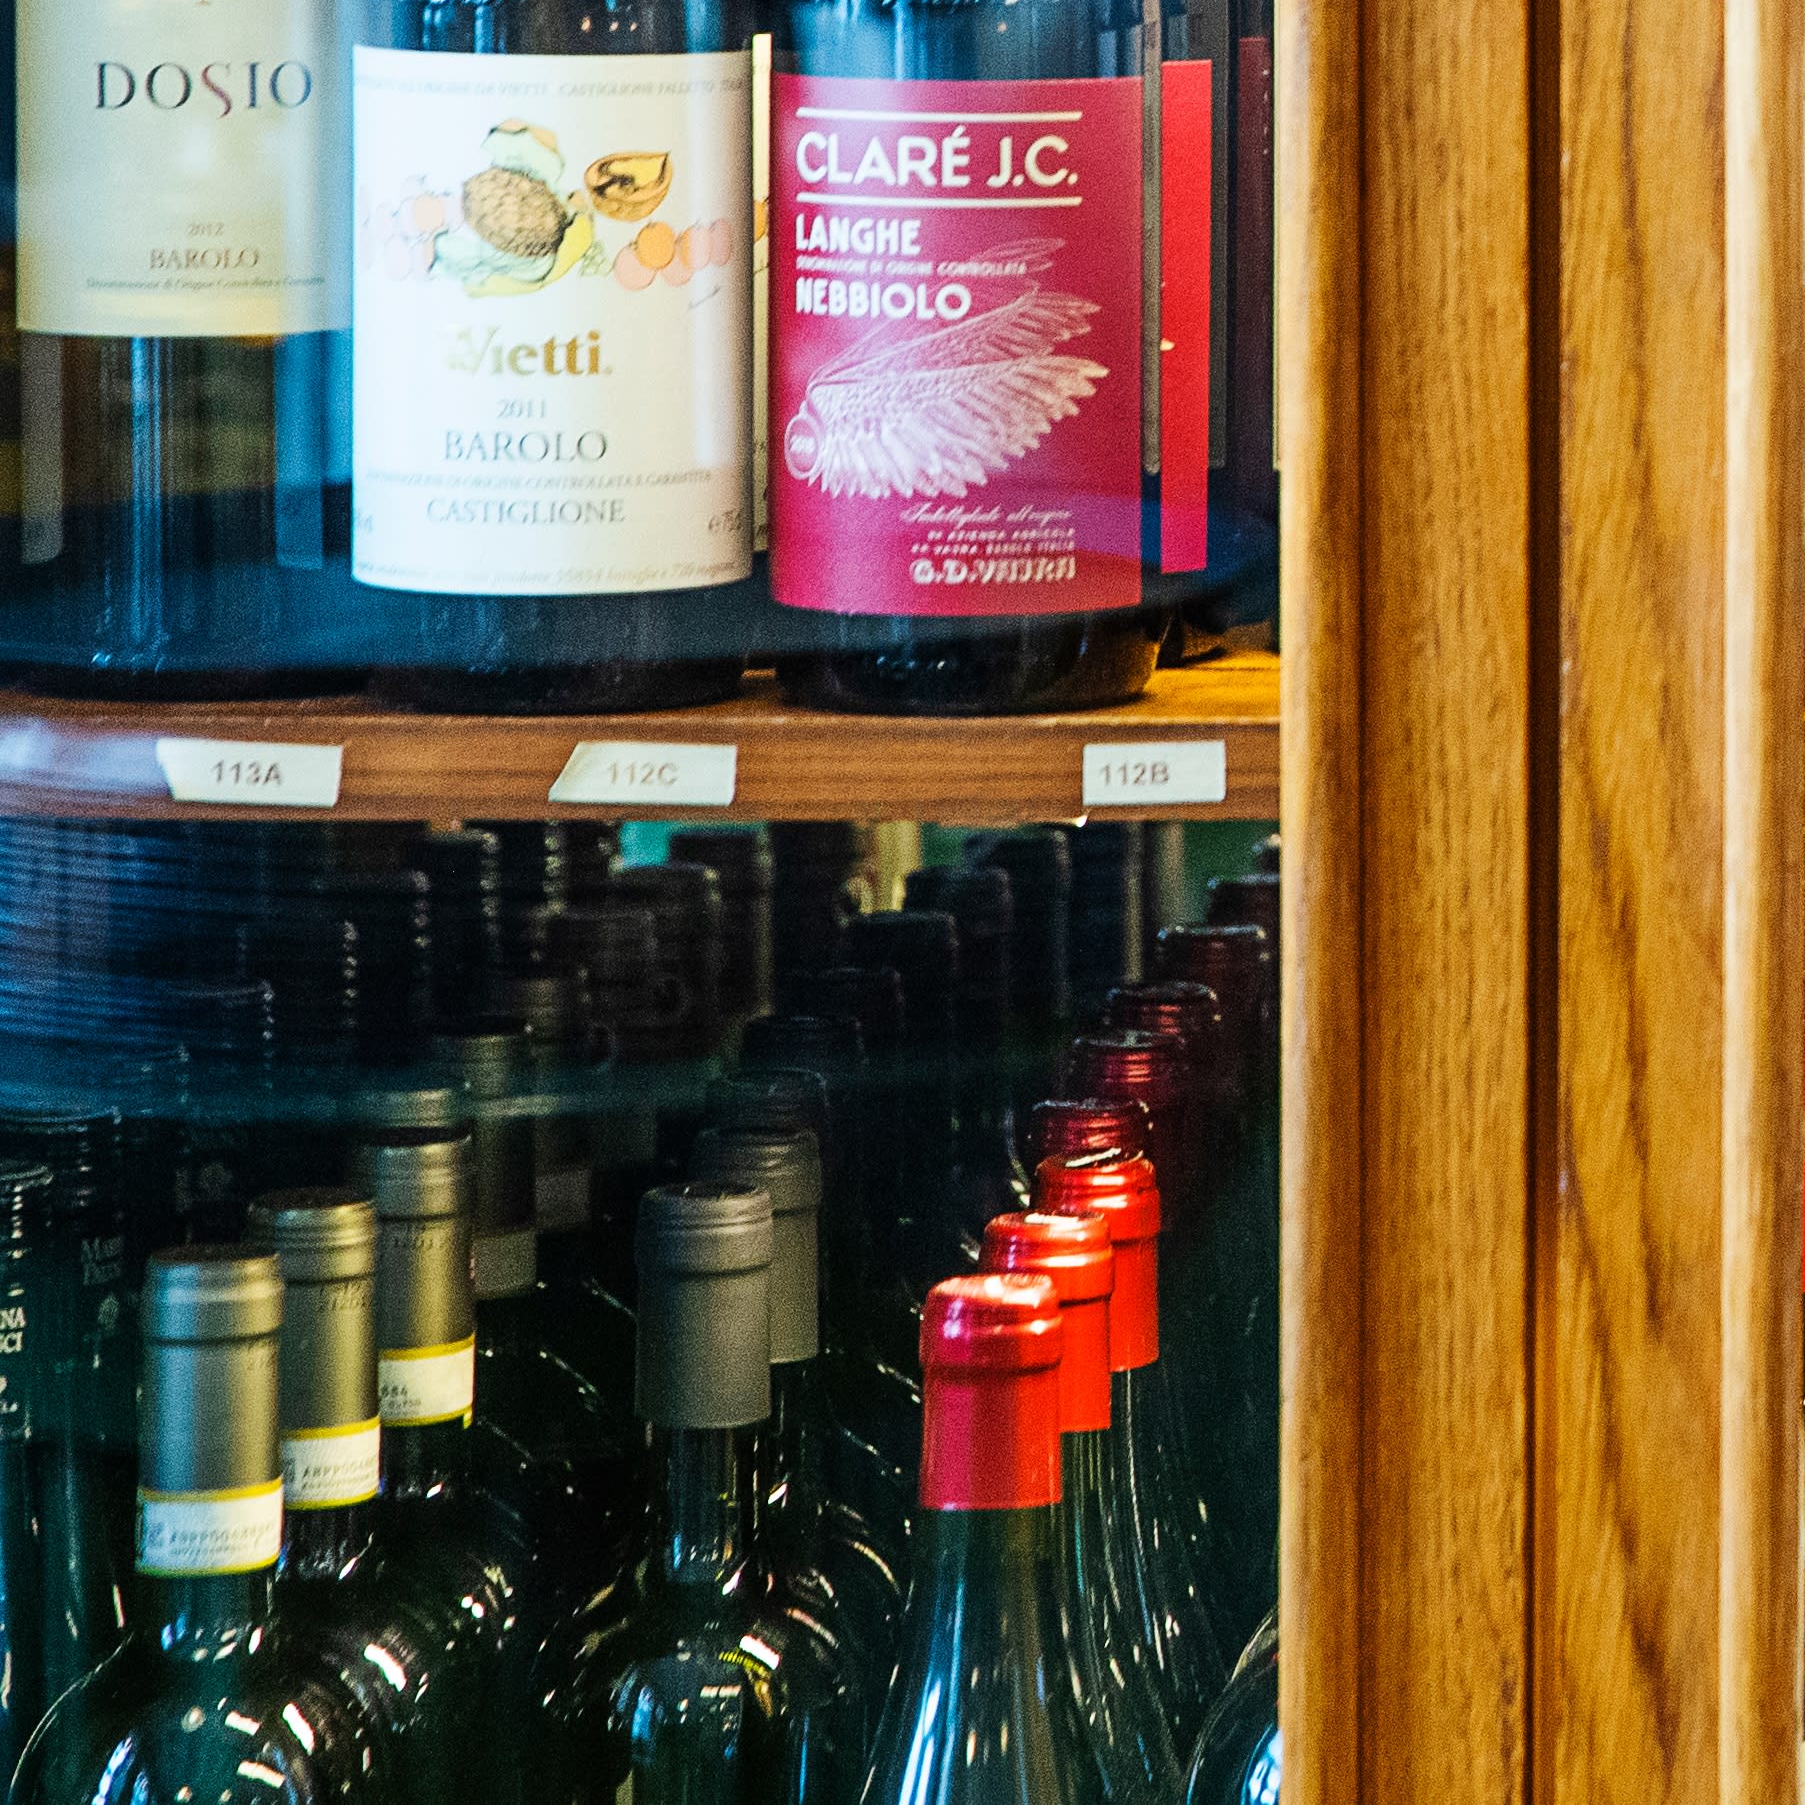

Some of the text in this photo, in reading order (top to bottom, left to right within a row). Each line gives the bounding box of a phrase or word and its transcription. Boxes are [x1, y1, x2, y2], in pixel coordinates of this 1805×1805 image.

[94, 60, 313, 119] DOSIO
[795, 125, 1079, 188] CLARÉ J.C.
[795, 213, 922, 256] LANGHE
[149, 247, 260, 271] BAROLO
[795, 276, 973, 321] NEBBIOLO
[443, 431, 610, 464] BAROLO
[426, 497, 626, 526] CASTIGLIONE
[210, 758, 284, 788] 113A
[605, 758, 679, 787] 112C
[1099, 760, 1171, 787] 112B
